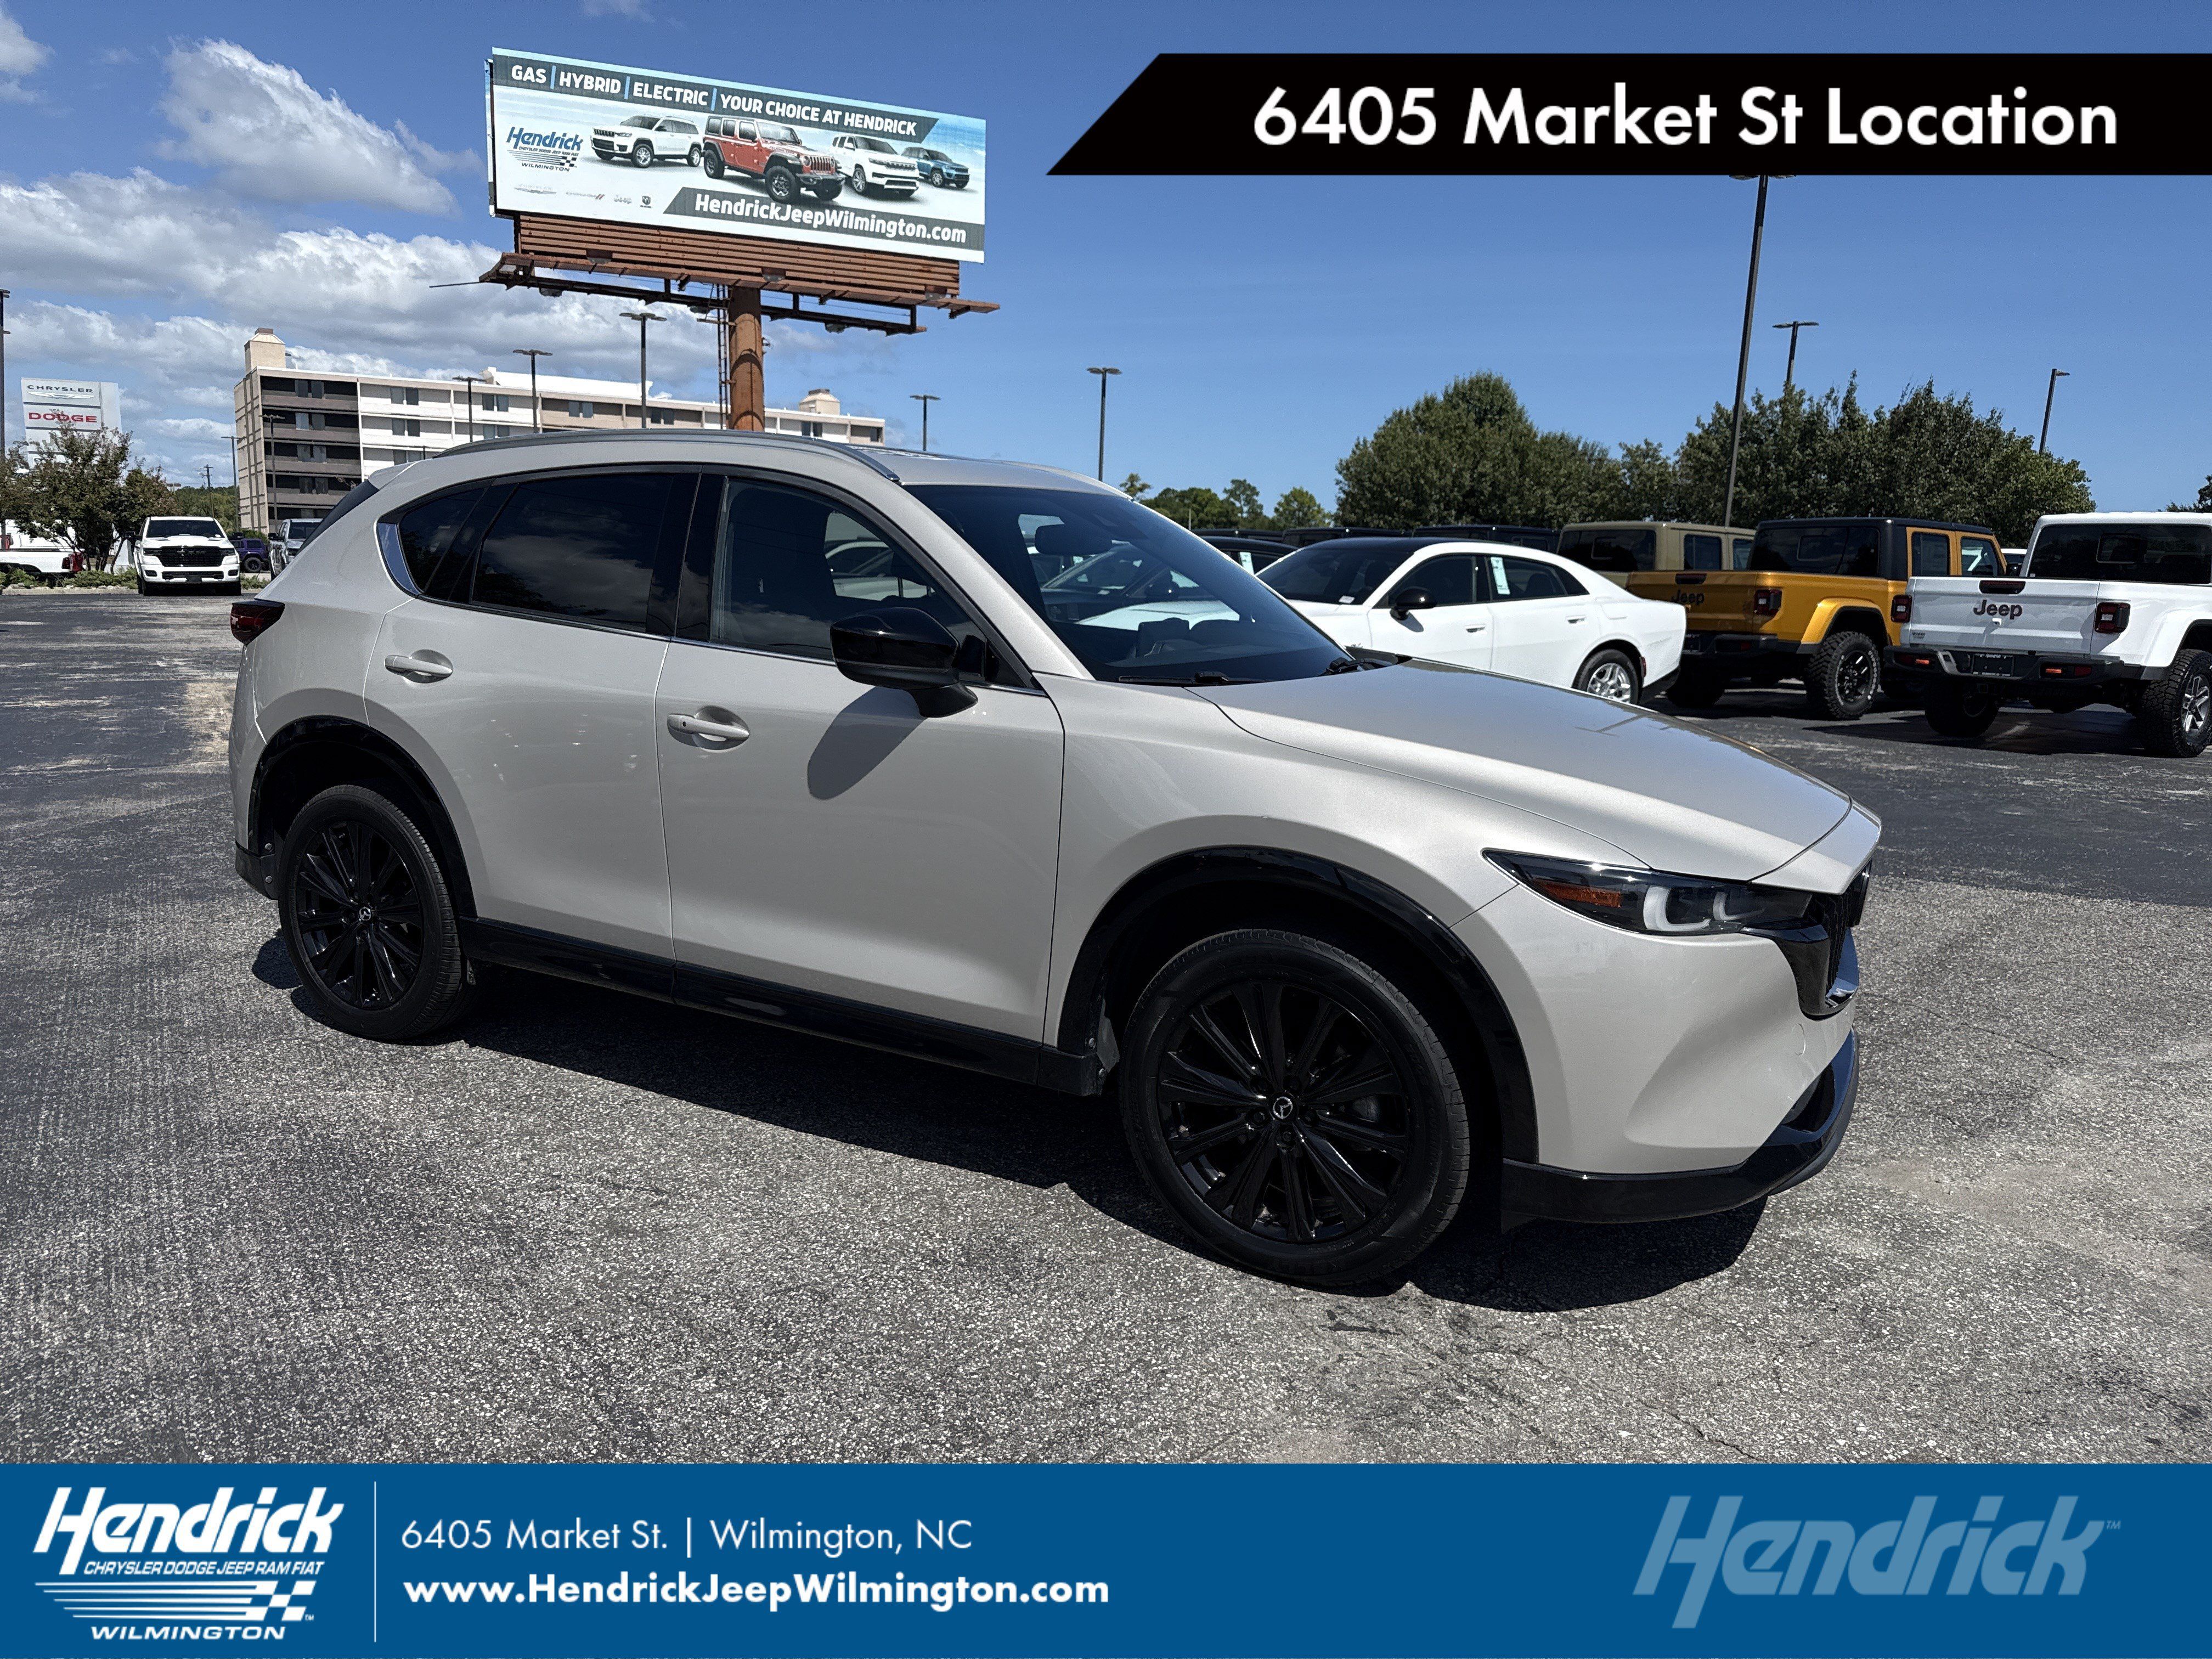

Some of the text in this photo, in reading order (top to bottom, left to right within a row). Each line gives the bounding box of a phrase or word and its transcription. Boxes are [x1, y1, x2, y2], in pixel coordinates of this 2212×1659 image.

[511, 65, 917, 136] GAS HYBRID ELECTRIC YOUR CHOICE AT HENDRICK
[506, 127, 584, 151] Hendrick
[521, 162, 570, 172] WILMINGTON
[695, 194, 967, 243] HendrickJeepWilmington.com
[27, 385, 93, 393] CHRYSLER
[29, 413, 98, 423] DODGE
[1671, 589, 1705, 605] Jeep
[1973, 600, 2022, 620] Jeep
